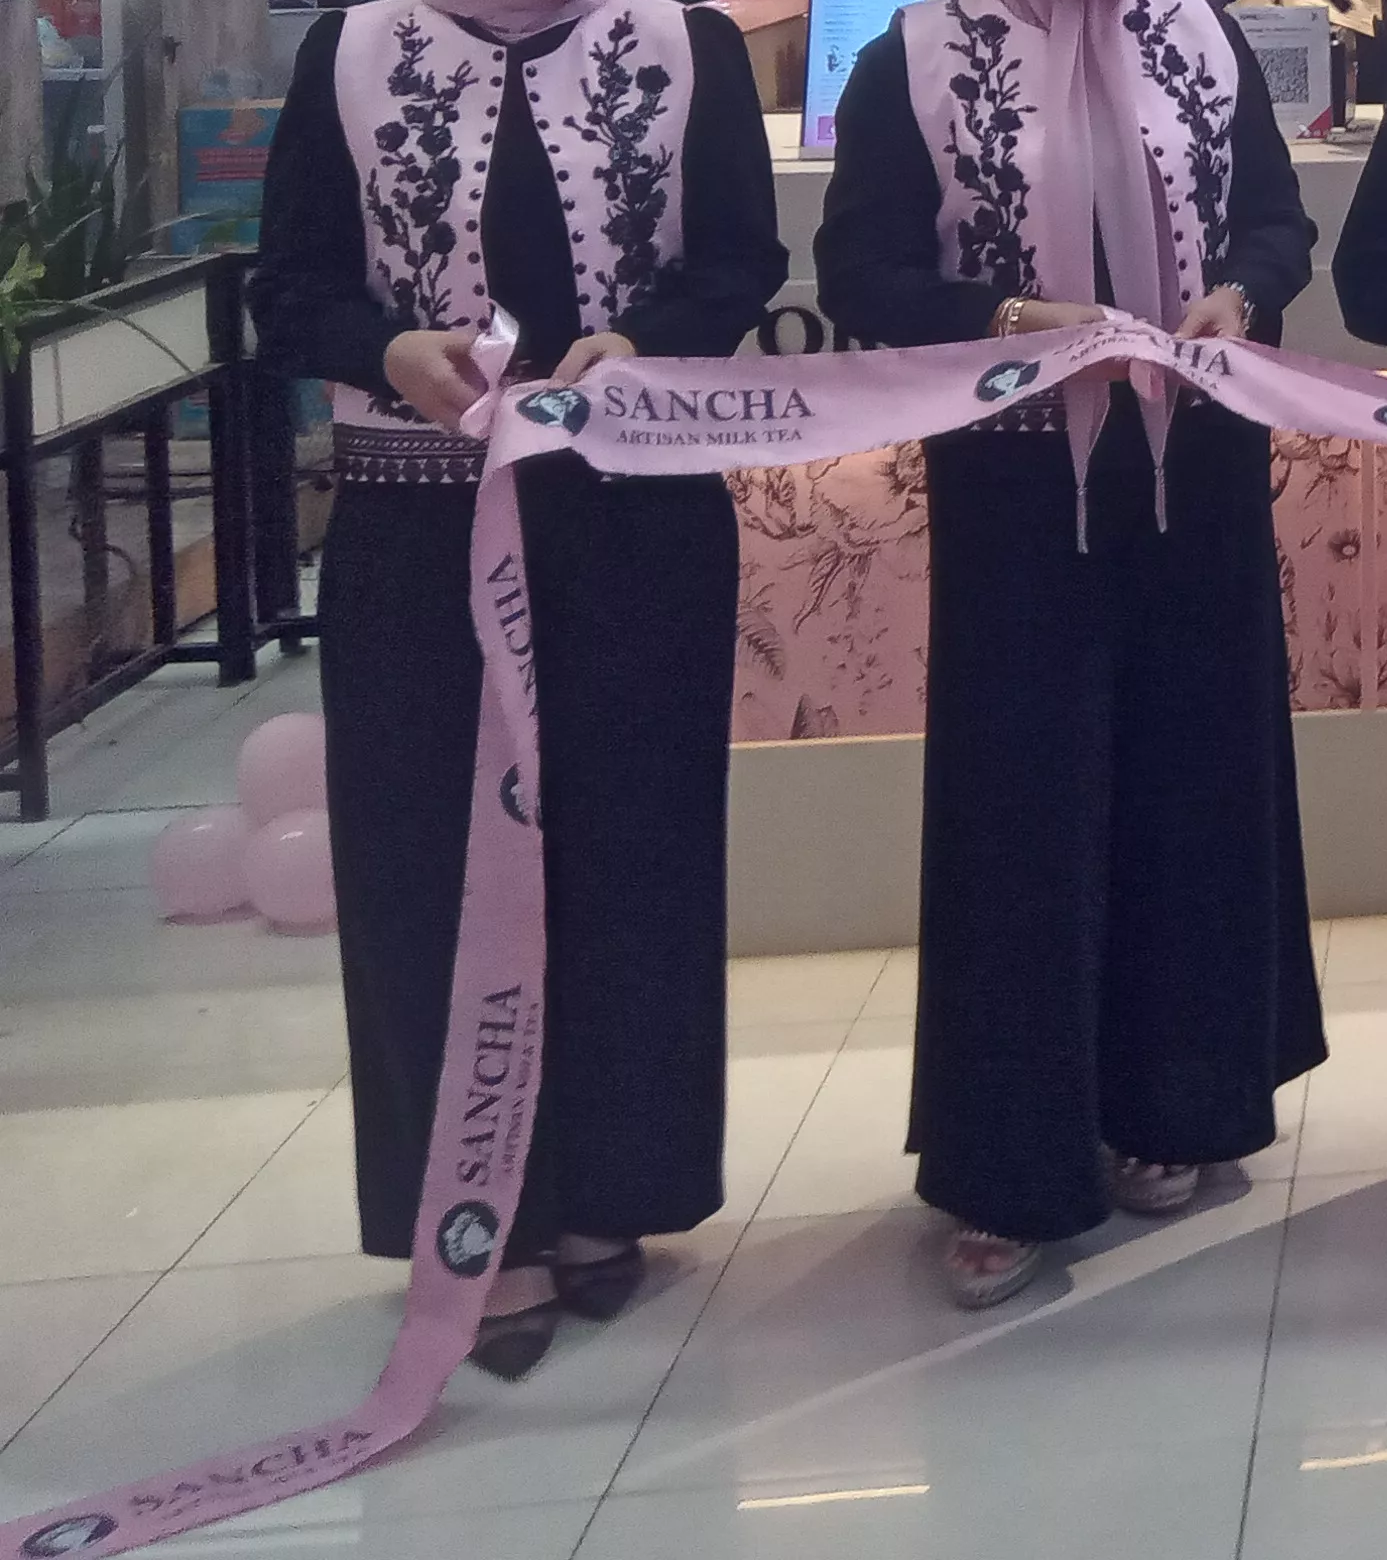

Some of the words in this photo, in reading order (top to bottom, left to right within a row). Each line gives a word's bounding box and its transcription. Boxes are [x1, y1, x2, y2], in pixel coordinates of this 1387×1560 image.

[603, 384, 816, 423] SANCHA
[615, 429, 700, 446] ARTISAN
[705, 430, 757, 446] MILK
[763, 428, 804, 445] TEA
[455, 984, 523, 1187] SANCHA
